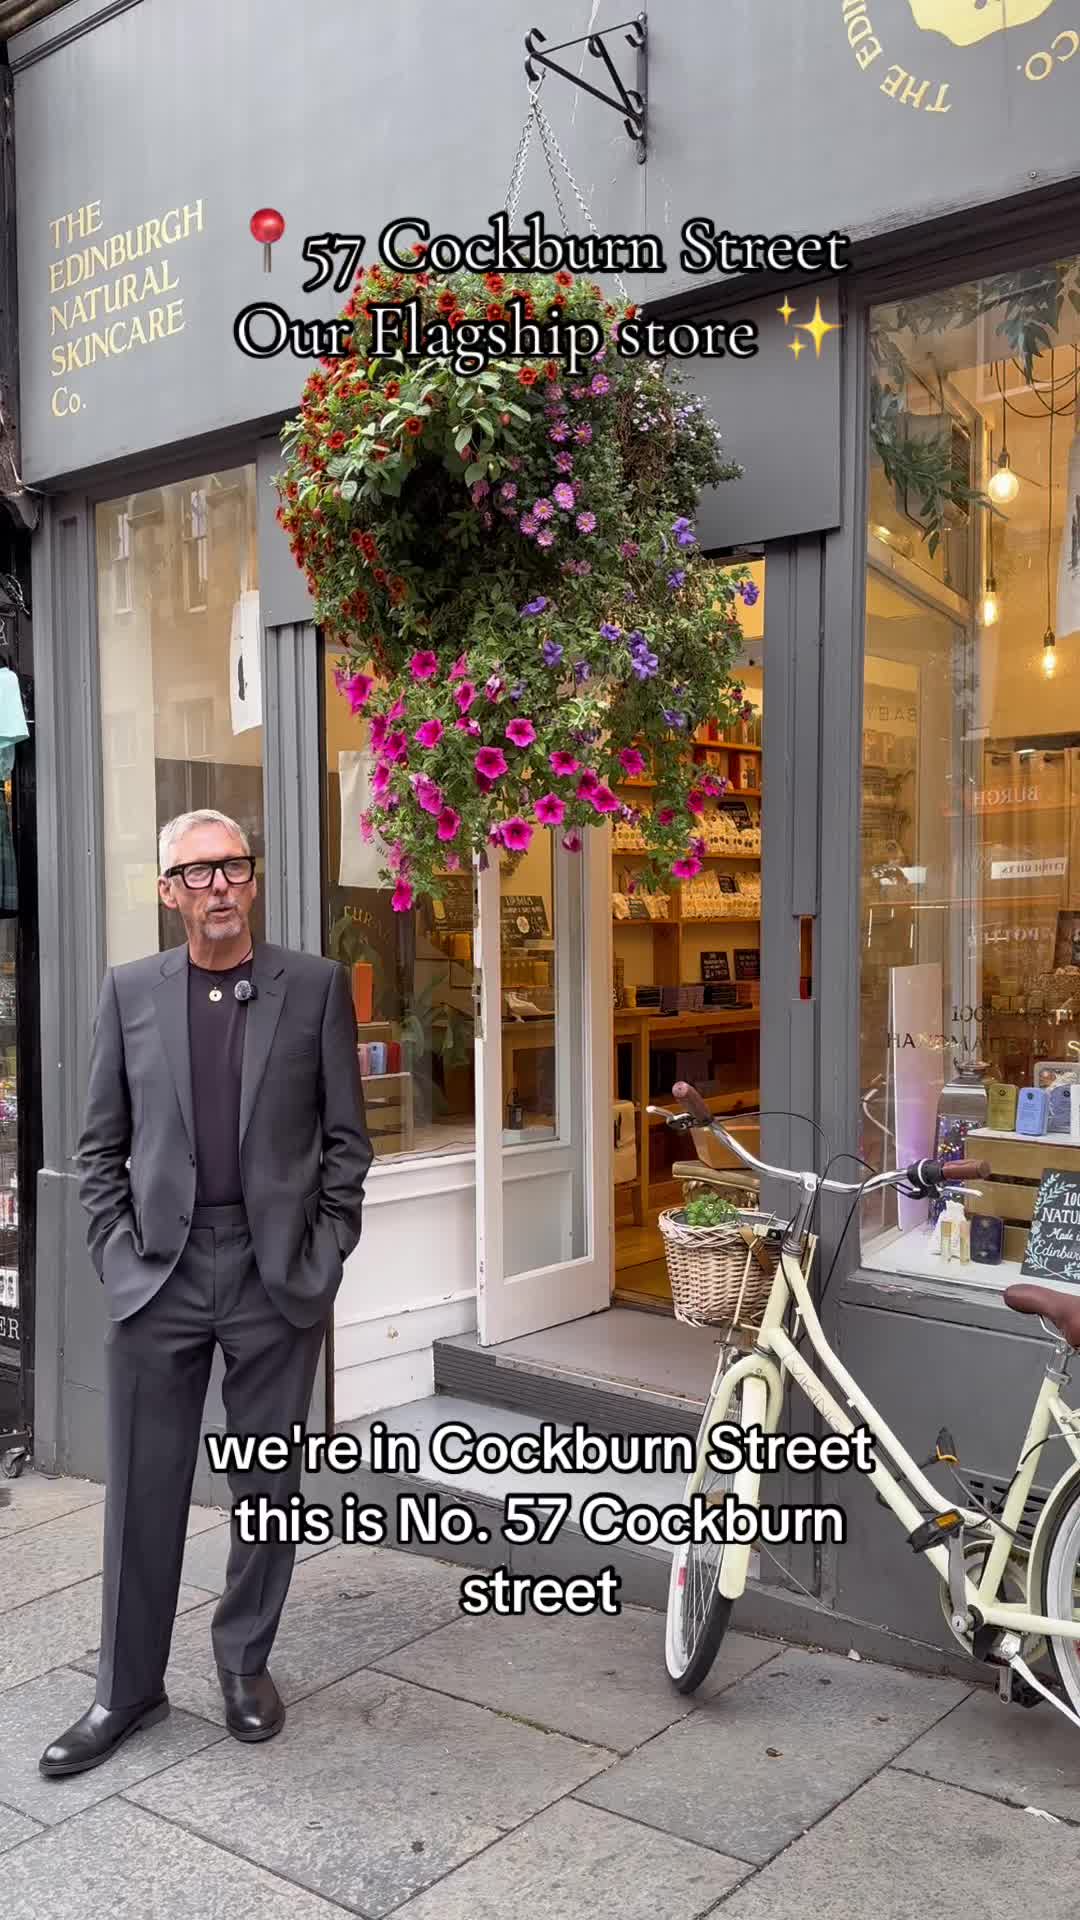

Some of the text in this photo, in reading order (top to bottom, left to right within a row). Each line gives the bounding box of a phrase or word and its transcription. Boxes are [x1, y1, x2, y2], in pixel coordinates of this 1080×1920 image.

[880, 63, 952, 112] THE
[49, 200, 104, 249] THE
[49, 200, 204, 293] EDINBURGH
[50, 259, 180, 336] NATURAL
[50, 299, 187, 377] SKINCARE
[51, 386, 87, 417] Co.
